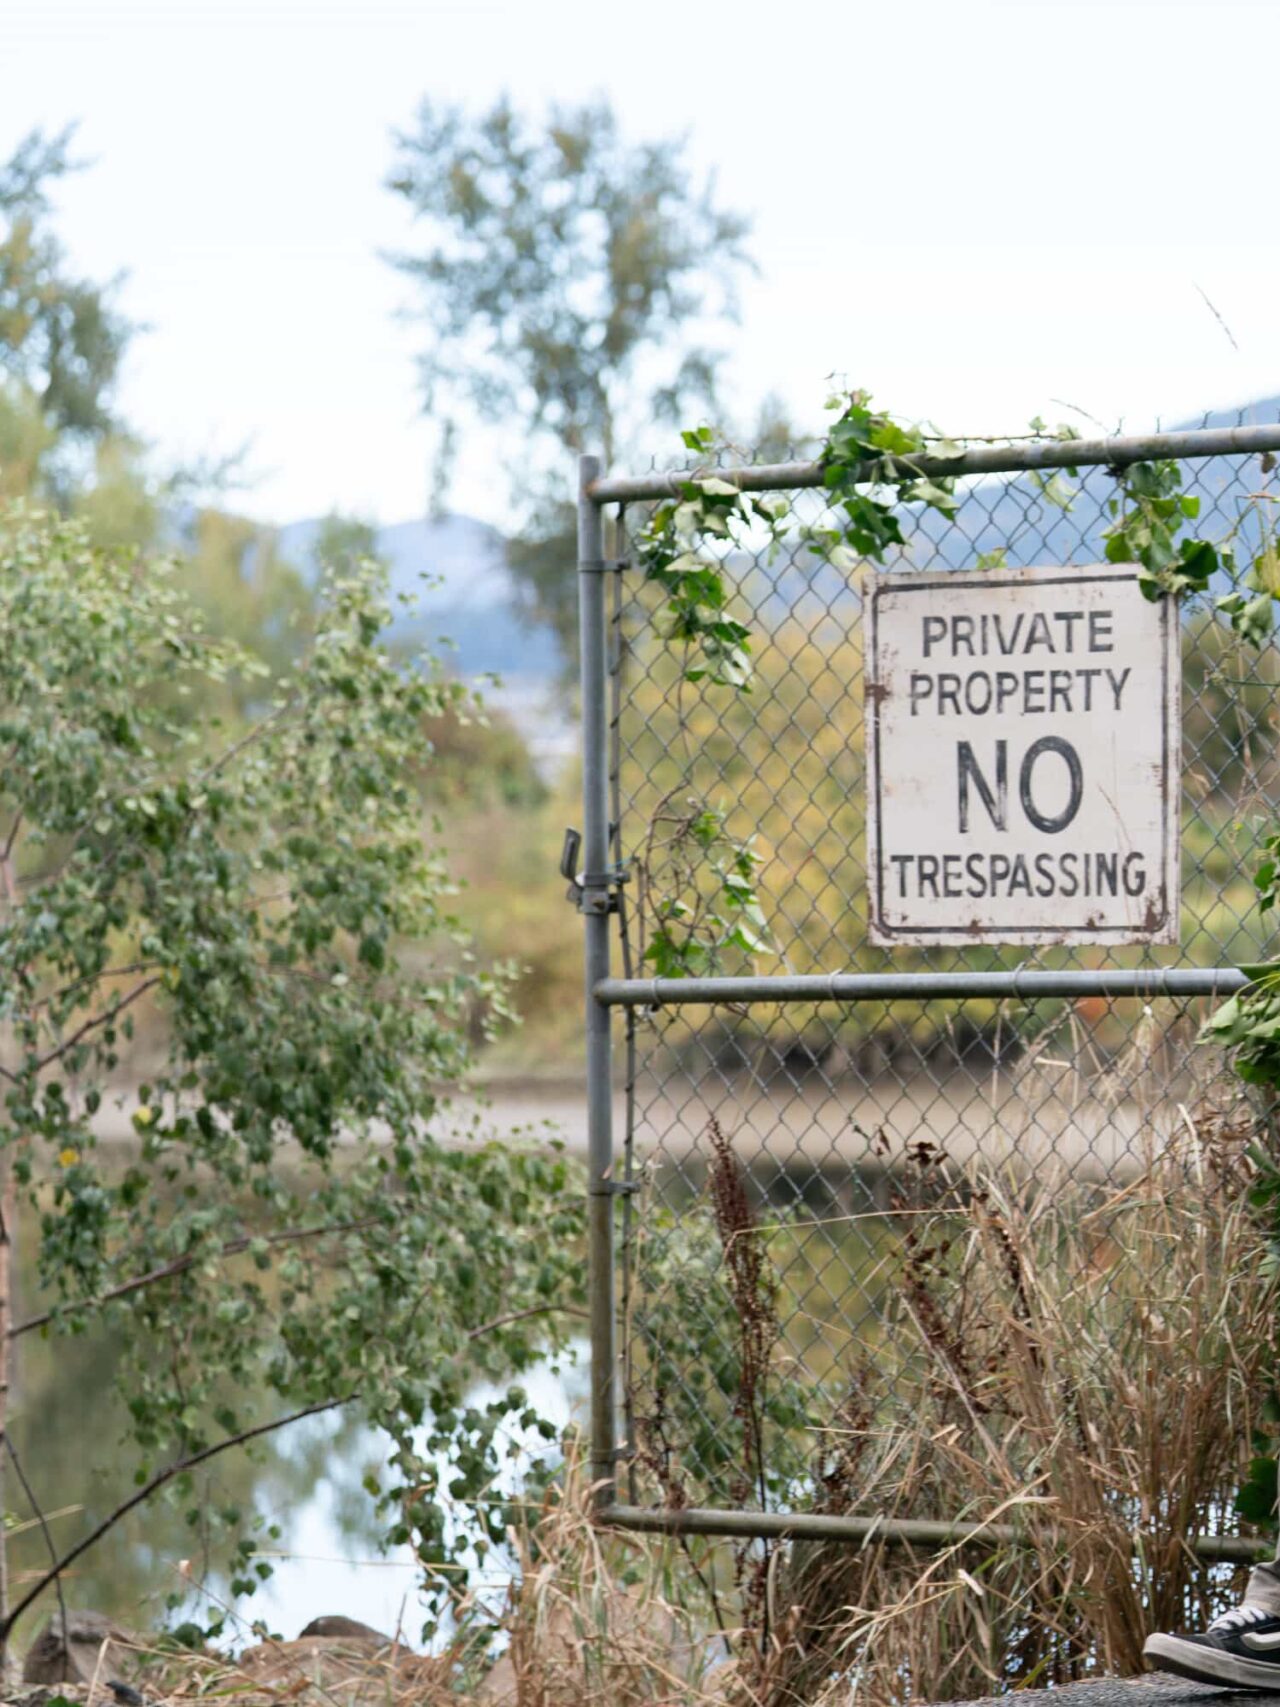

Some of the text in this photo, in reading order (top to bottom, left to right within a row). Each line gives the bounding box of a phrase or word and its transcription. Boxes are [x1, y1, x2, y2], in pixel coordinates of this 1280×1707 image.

[922, 610, 1114, 657] PRIVATE
[909, 667, 1131, 716] PROPERTY
[956, 735, 1084, 834] NO
[890, 851, 1147, 898] TRESPASSING
